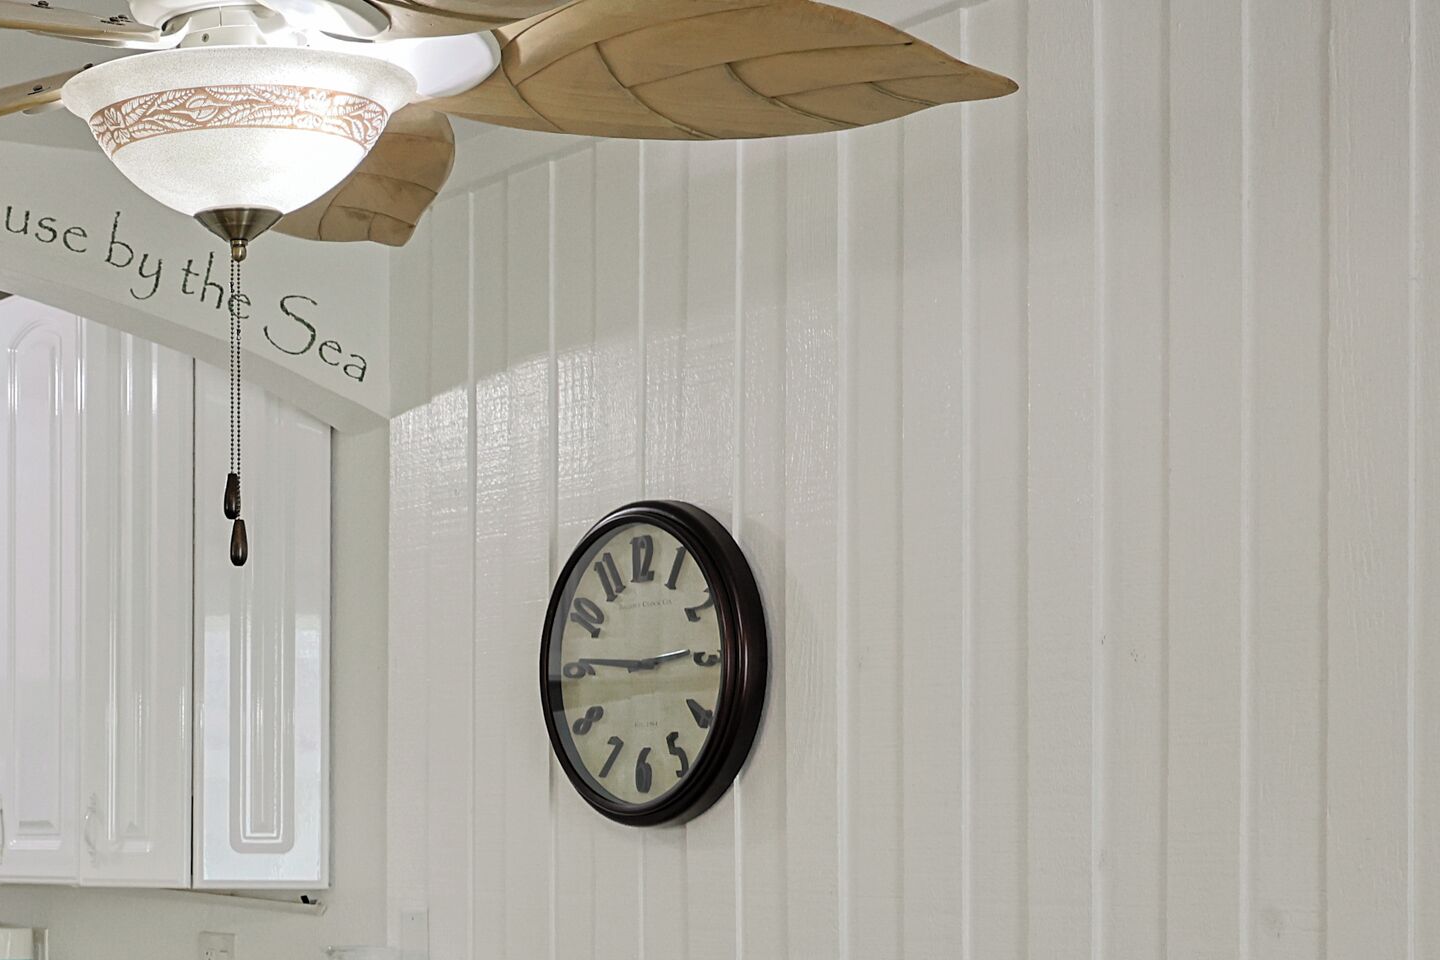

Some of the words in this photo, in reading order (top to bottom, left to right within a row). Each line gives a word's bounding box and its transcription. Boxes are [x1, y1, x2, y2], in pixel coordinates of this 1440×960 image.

[104, 211, 162, 300] by
[181, 250, 251, 319] the
[263, 294, 368, 382] Sea
[593, 552, 627, 602] 11
[630, 534, 655, 583] 12
[664, 546, 688, 590] 1
[570, 597, 605, 638] 10
[562, 660, 596, 679] 9
[572, 705, 604, 736] 8
[598, 736, 625, 778] 7
[635, 747, 653, 794] 6
[666, 731, 690, 778] 5
